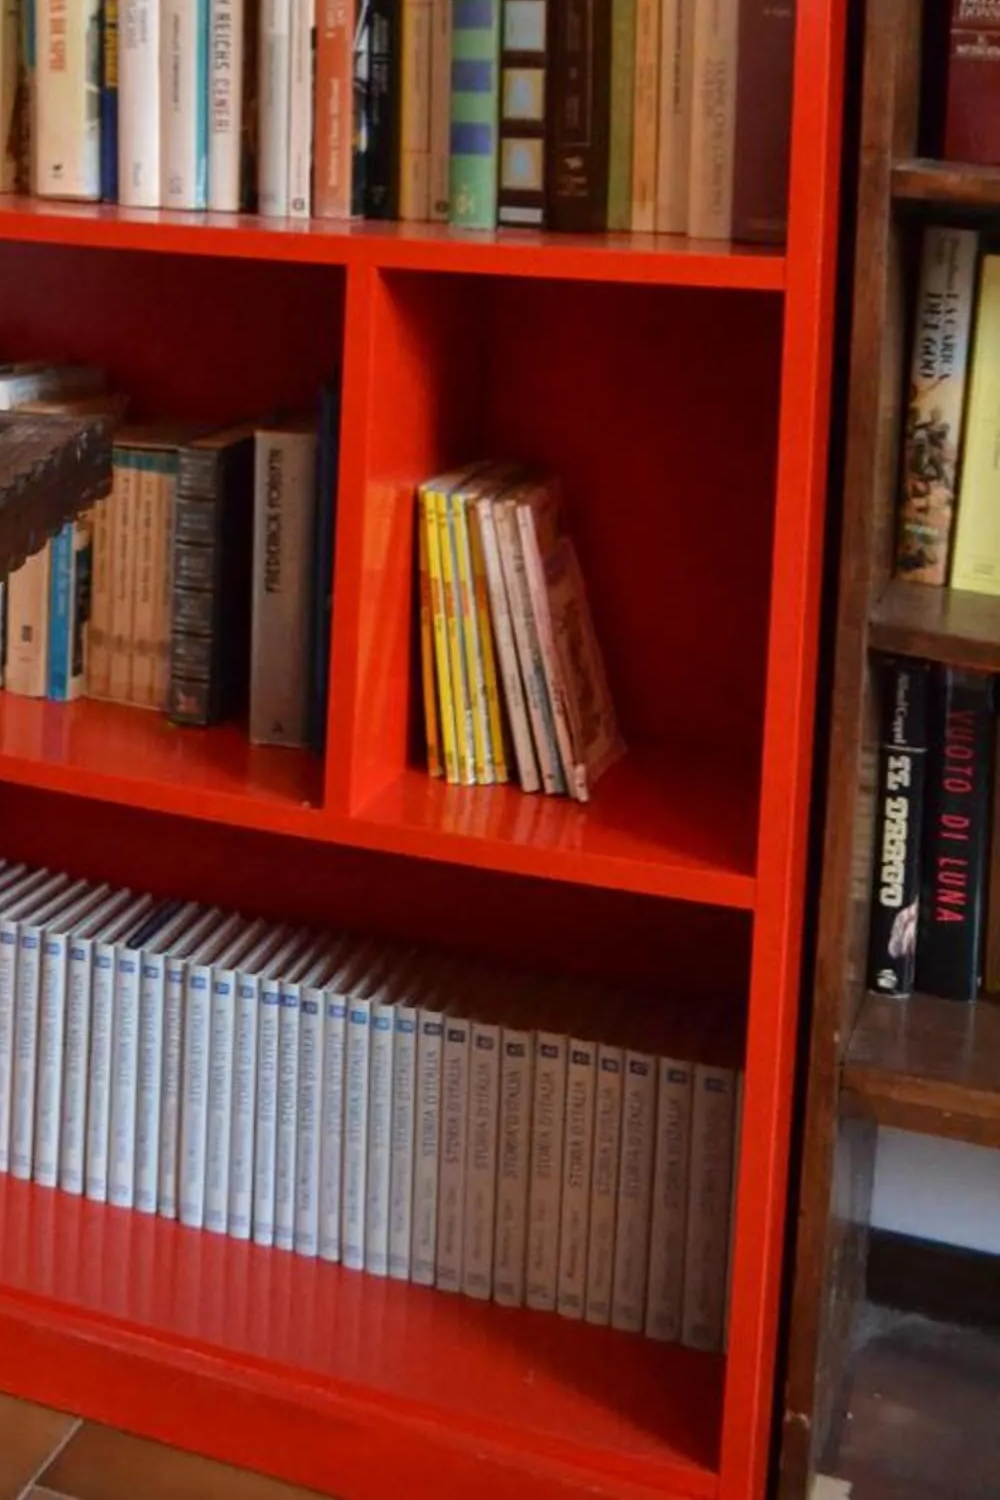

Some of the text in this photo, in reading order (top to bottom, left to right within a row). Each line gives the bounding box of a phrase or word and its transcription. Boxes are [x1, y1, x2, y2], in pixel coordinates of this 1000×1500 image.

[212, 19, 231, 71] REICHS
[941, 814, 970, 841] DI
[936, 857, 968, 923] LUNA
